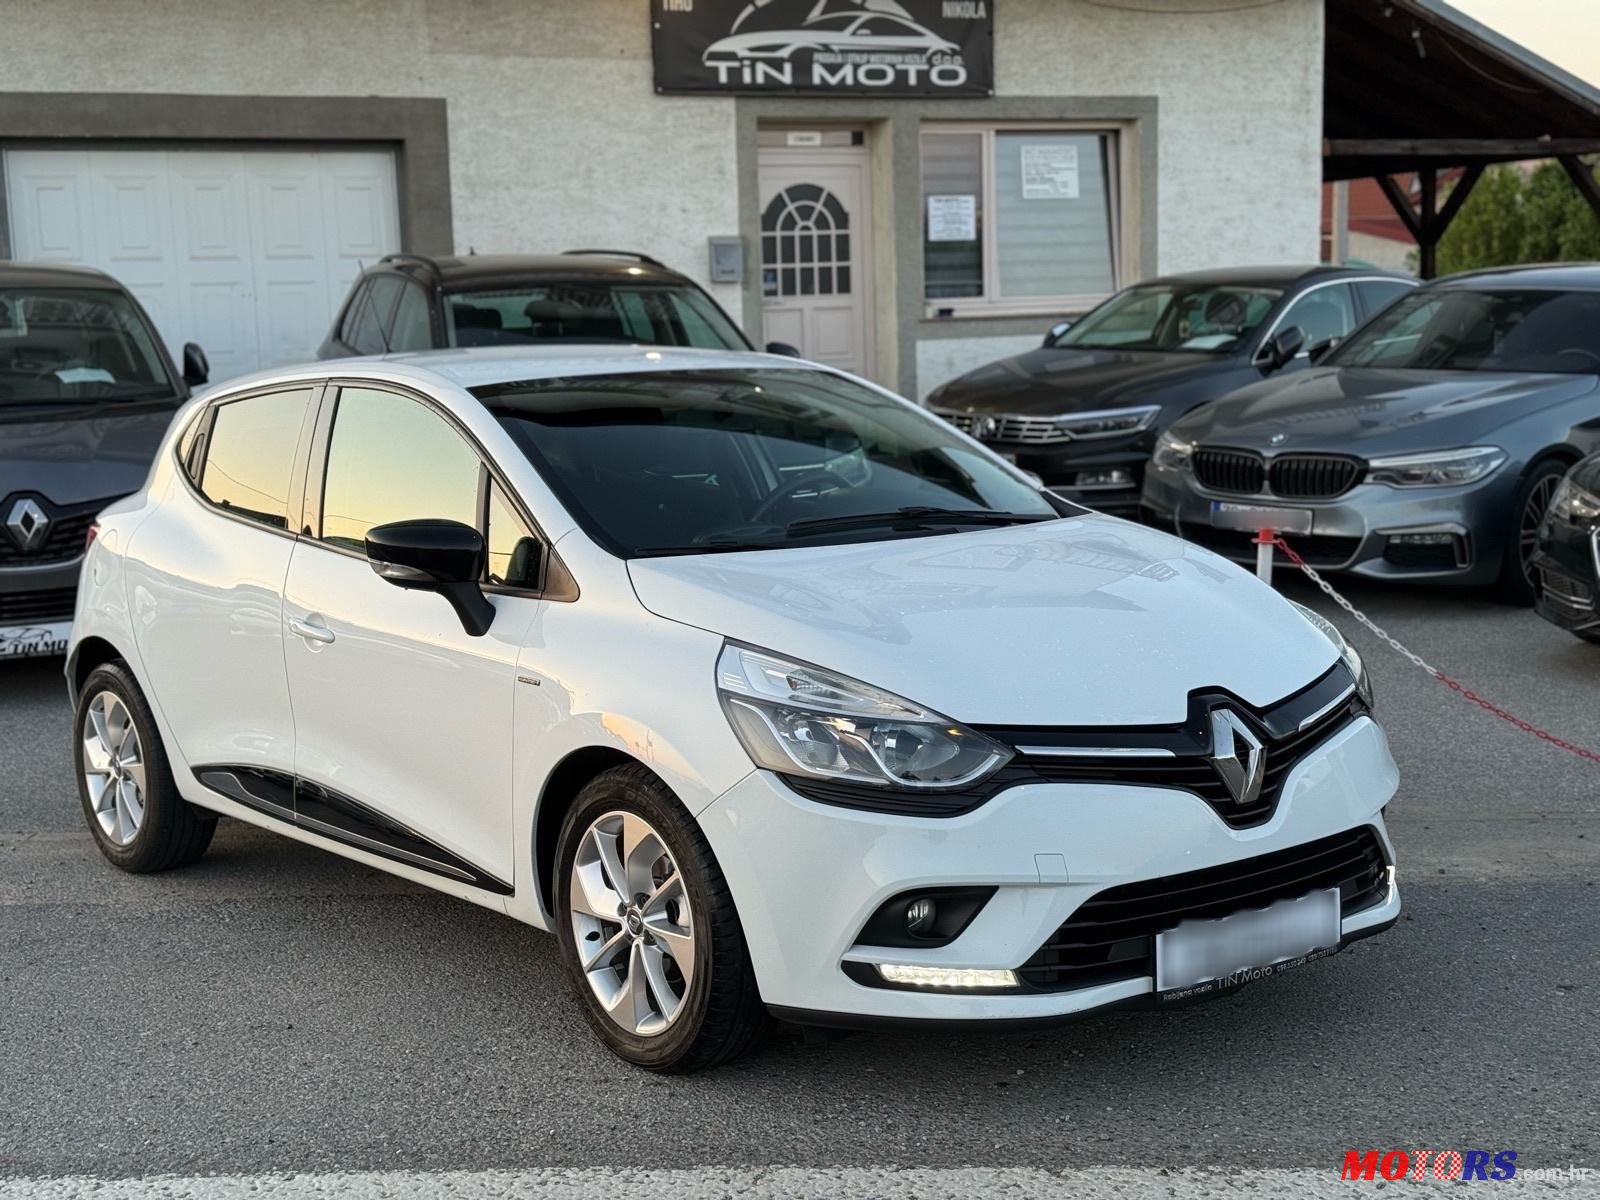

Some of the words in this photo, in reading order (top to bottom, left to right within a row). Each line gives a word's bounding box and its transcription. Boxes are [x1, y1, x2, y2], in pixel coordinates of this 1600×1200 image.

[942, 1, 987, 19] NIKOLA
[812, 64, 968, 87] MOTO
[1216, 971, 1238, 990] TIN
